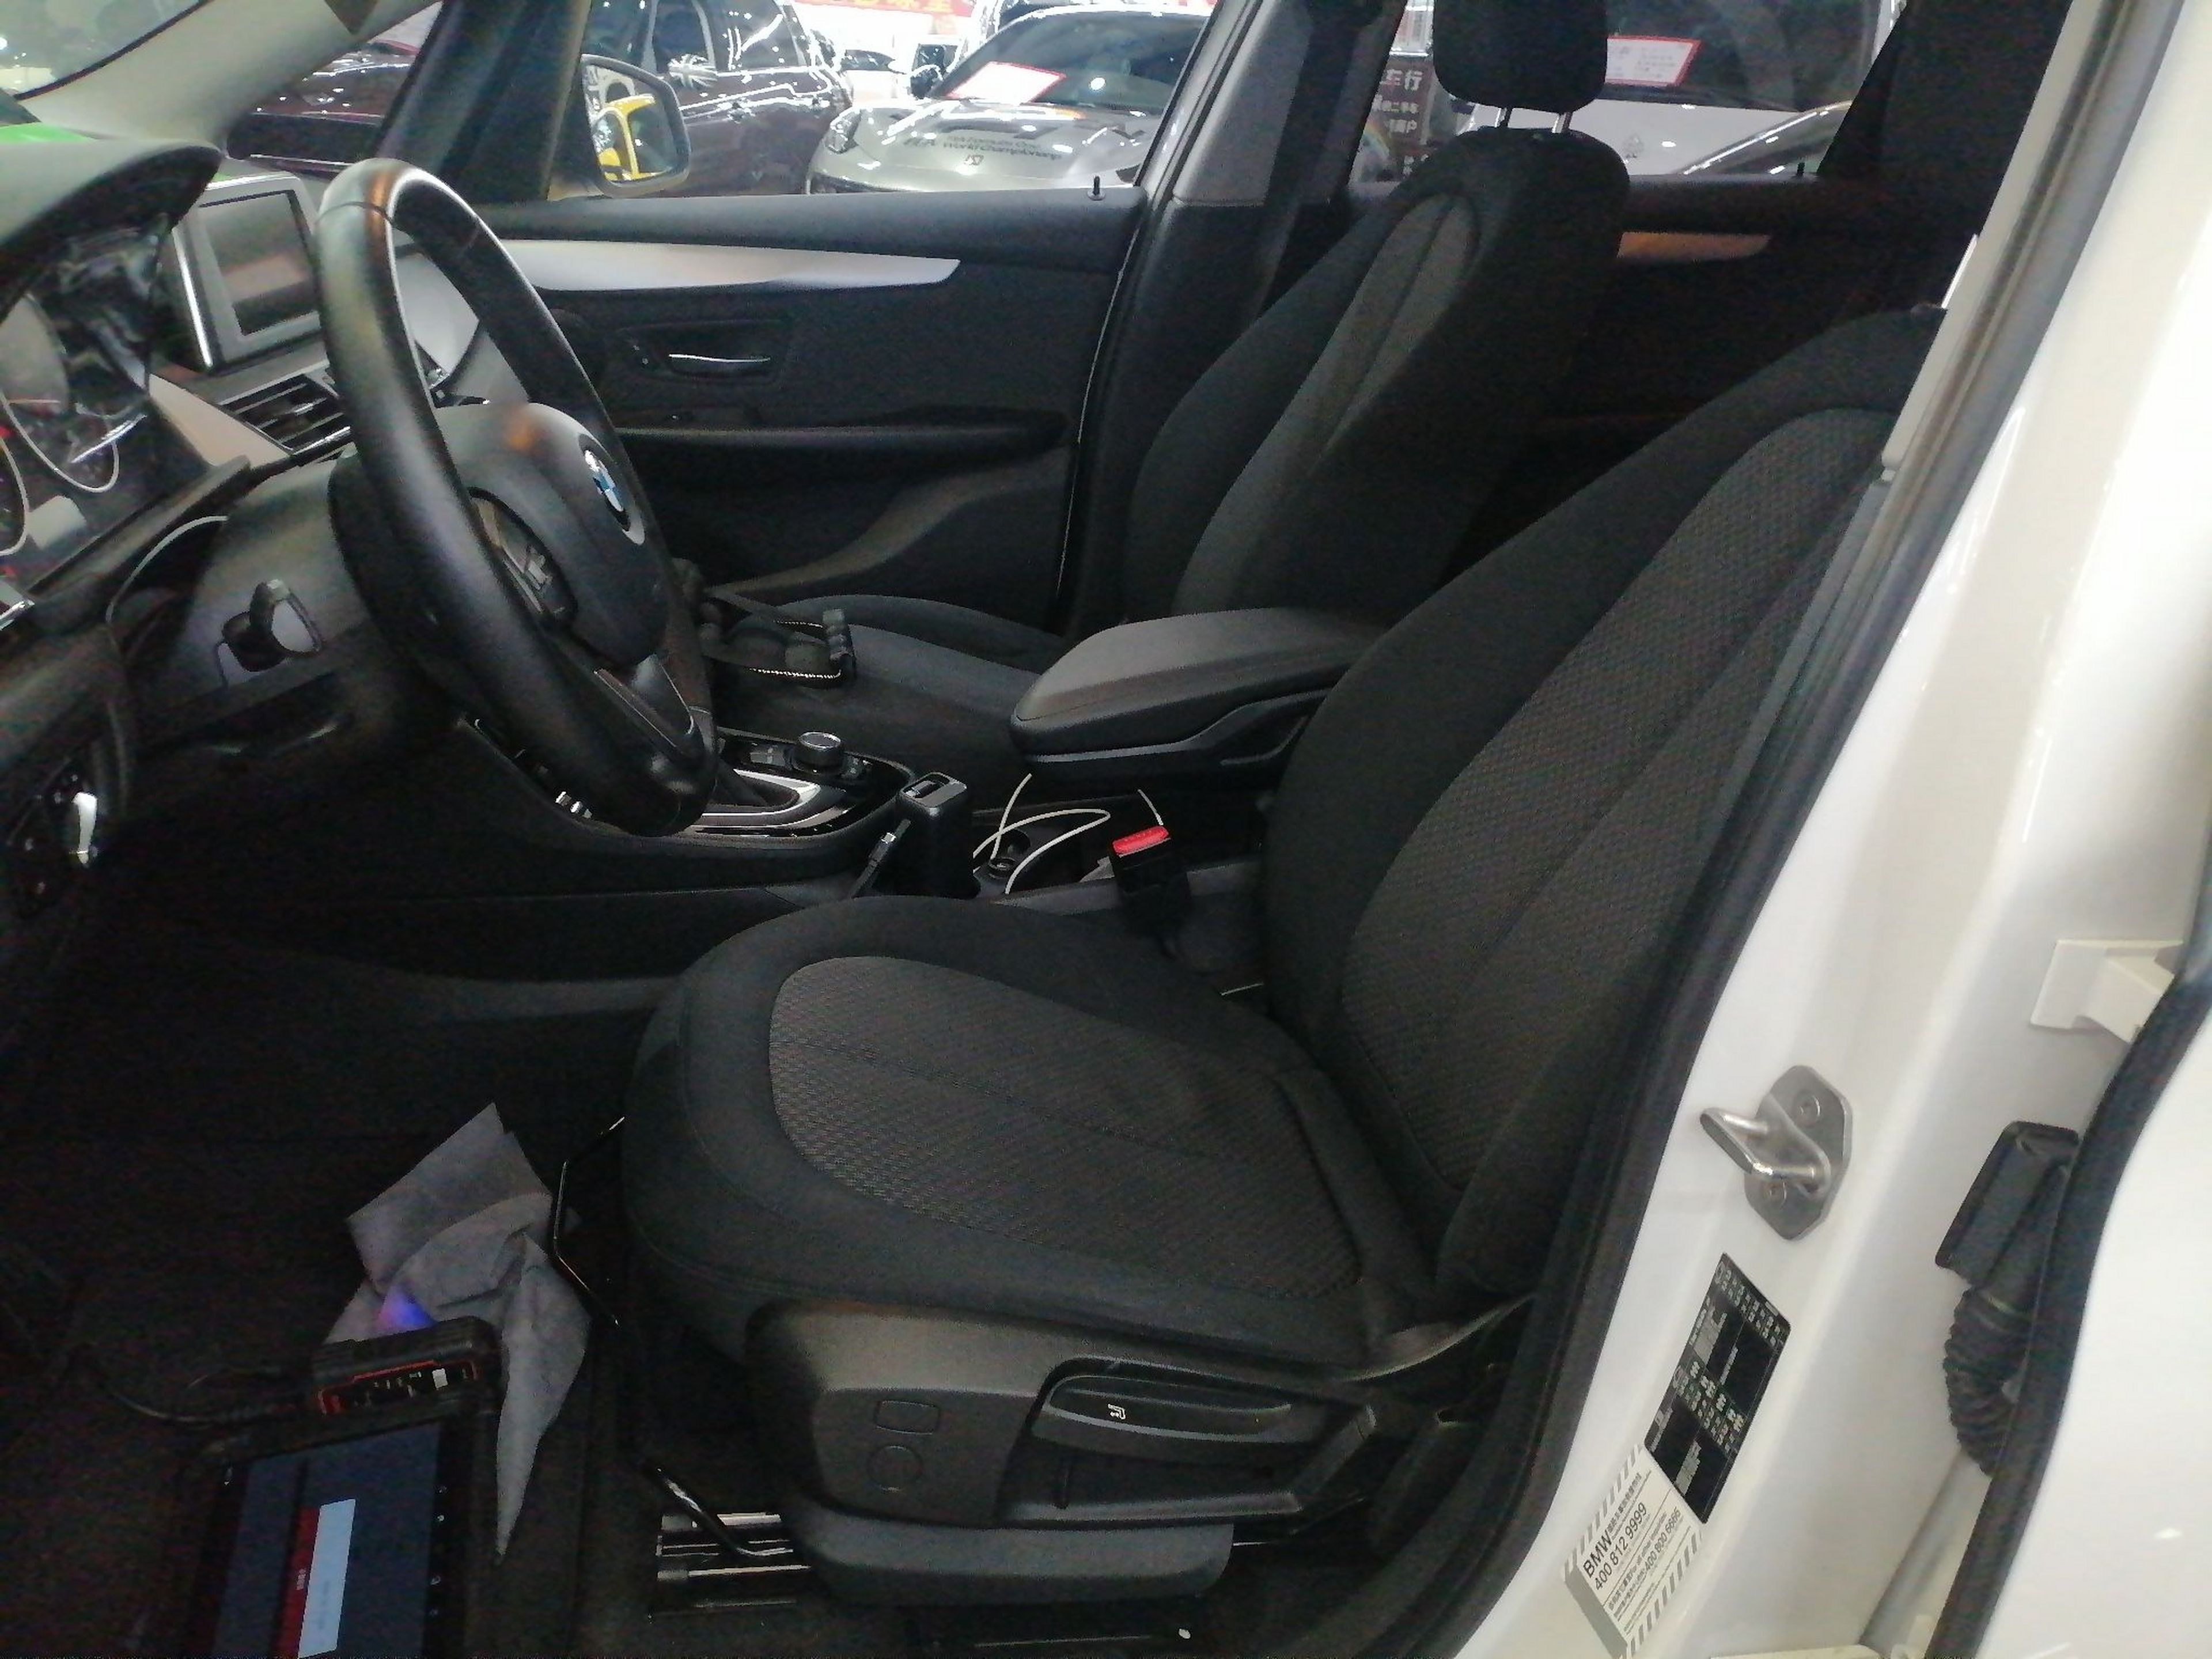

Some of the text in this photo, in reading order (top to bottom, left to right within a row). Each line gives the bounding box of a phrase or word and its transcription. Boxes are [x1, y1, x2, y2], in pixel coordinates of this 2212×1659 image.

[1584, 1530, 1612, 1578] BMW
[1595, 1562, 1612, 1590] 400
[1610, 1536, 1628, 1565] 812
[1625, 1502, 1647, 1539] 9999
[1645, 1551, 1657, 1570] 400
